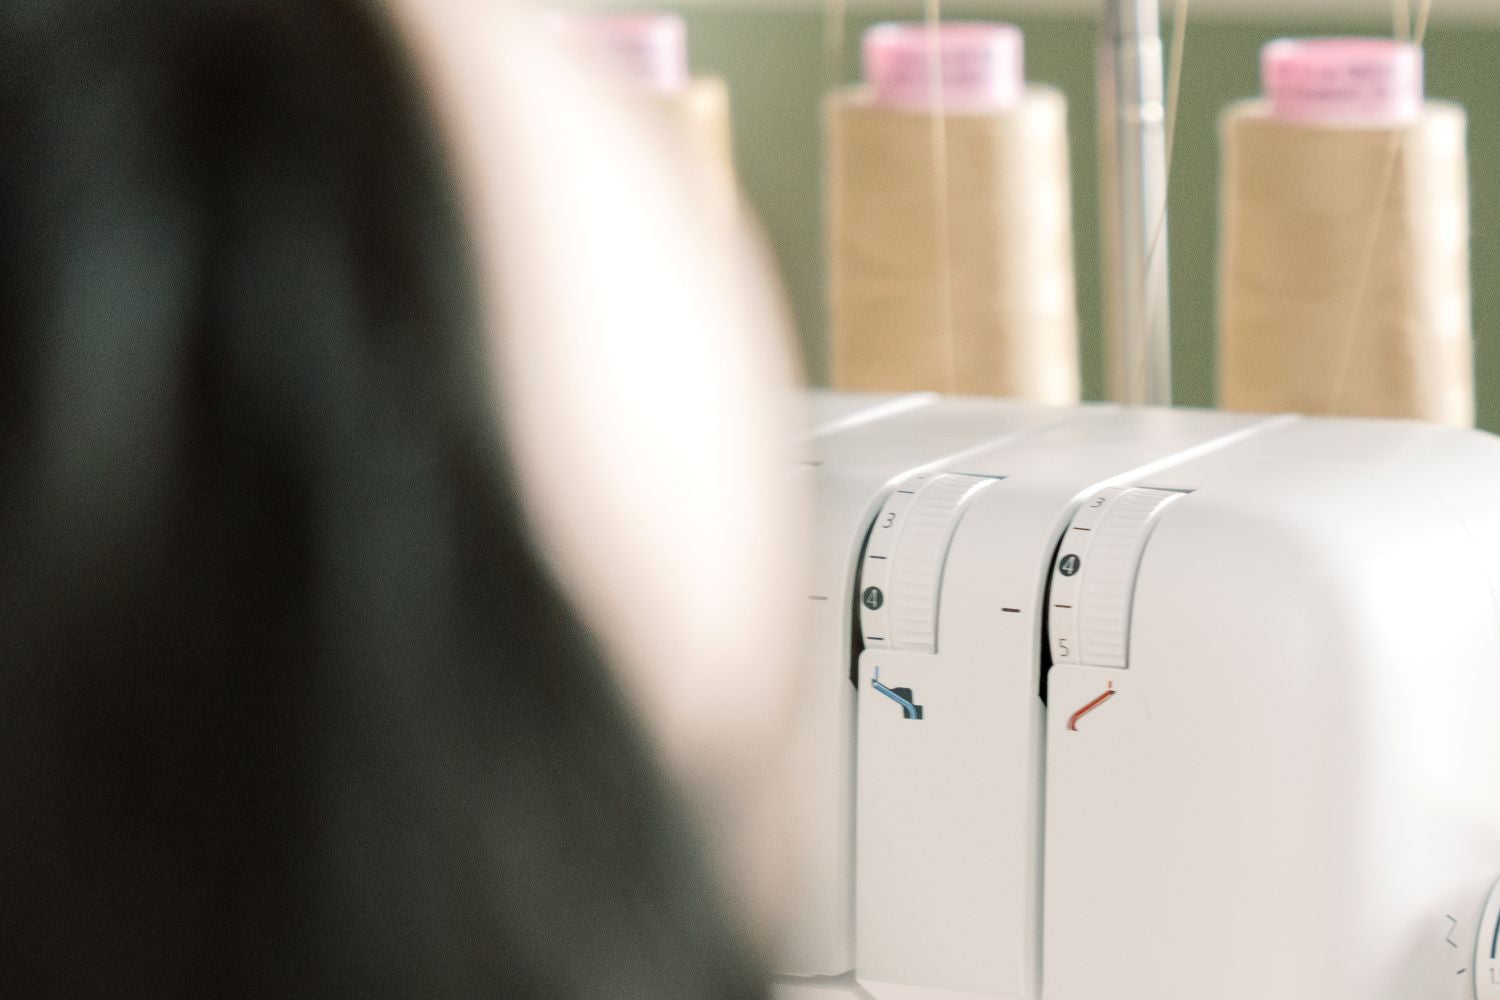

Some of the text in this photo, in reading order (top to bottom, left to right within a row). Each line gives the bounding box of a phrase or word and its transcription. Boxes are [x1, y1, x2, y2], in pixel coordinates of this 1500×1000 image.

[881, 512, 897, 529] 3
[1060, 555, 1078, 576] 4
[865, 588, 881, 610] 4
[1058, 638, 1070, 657] 5
